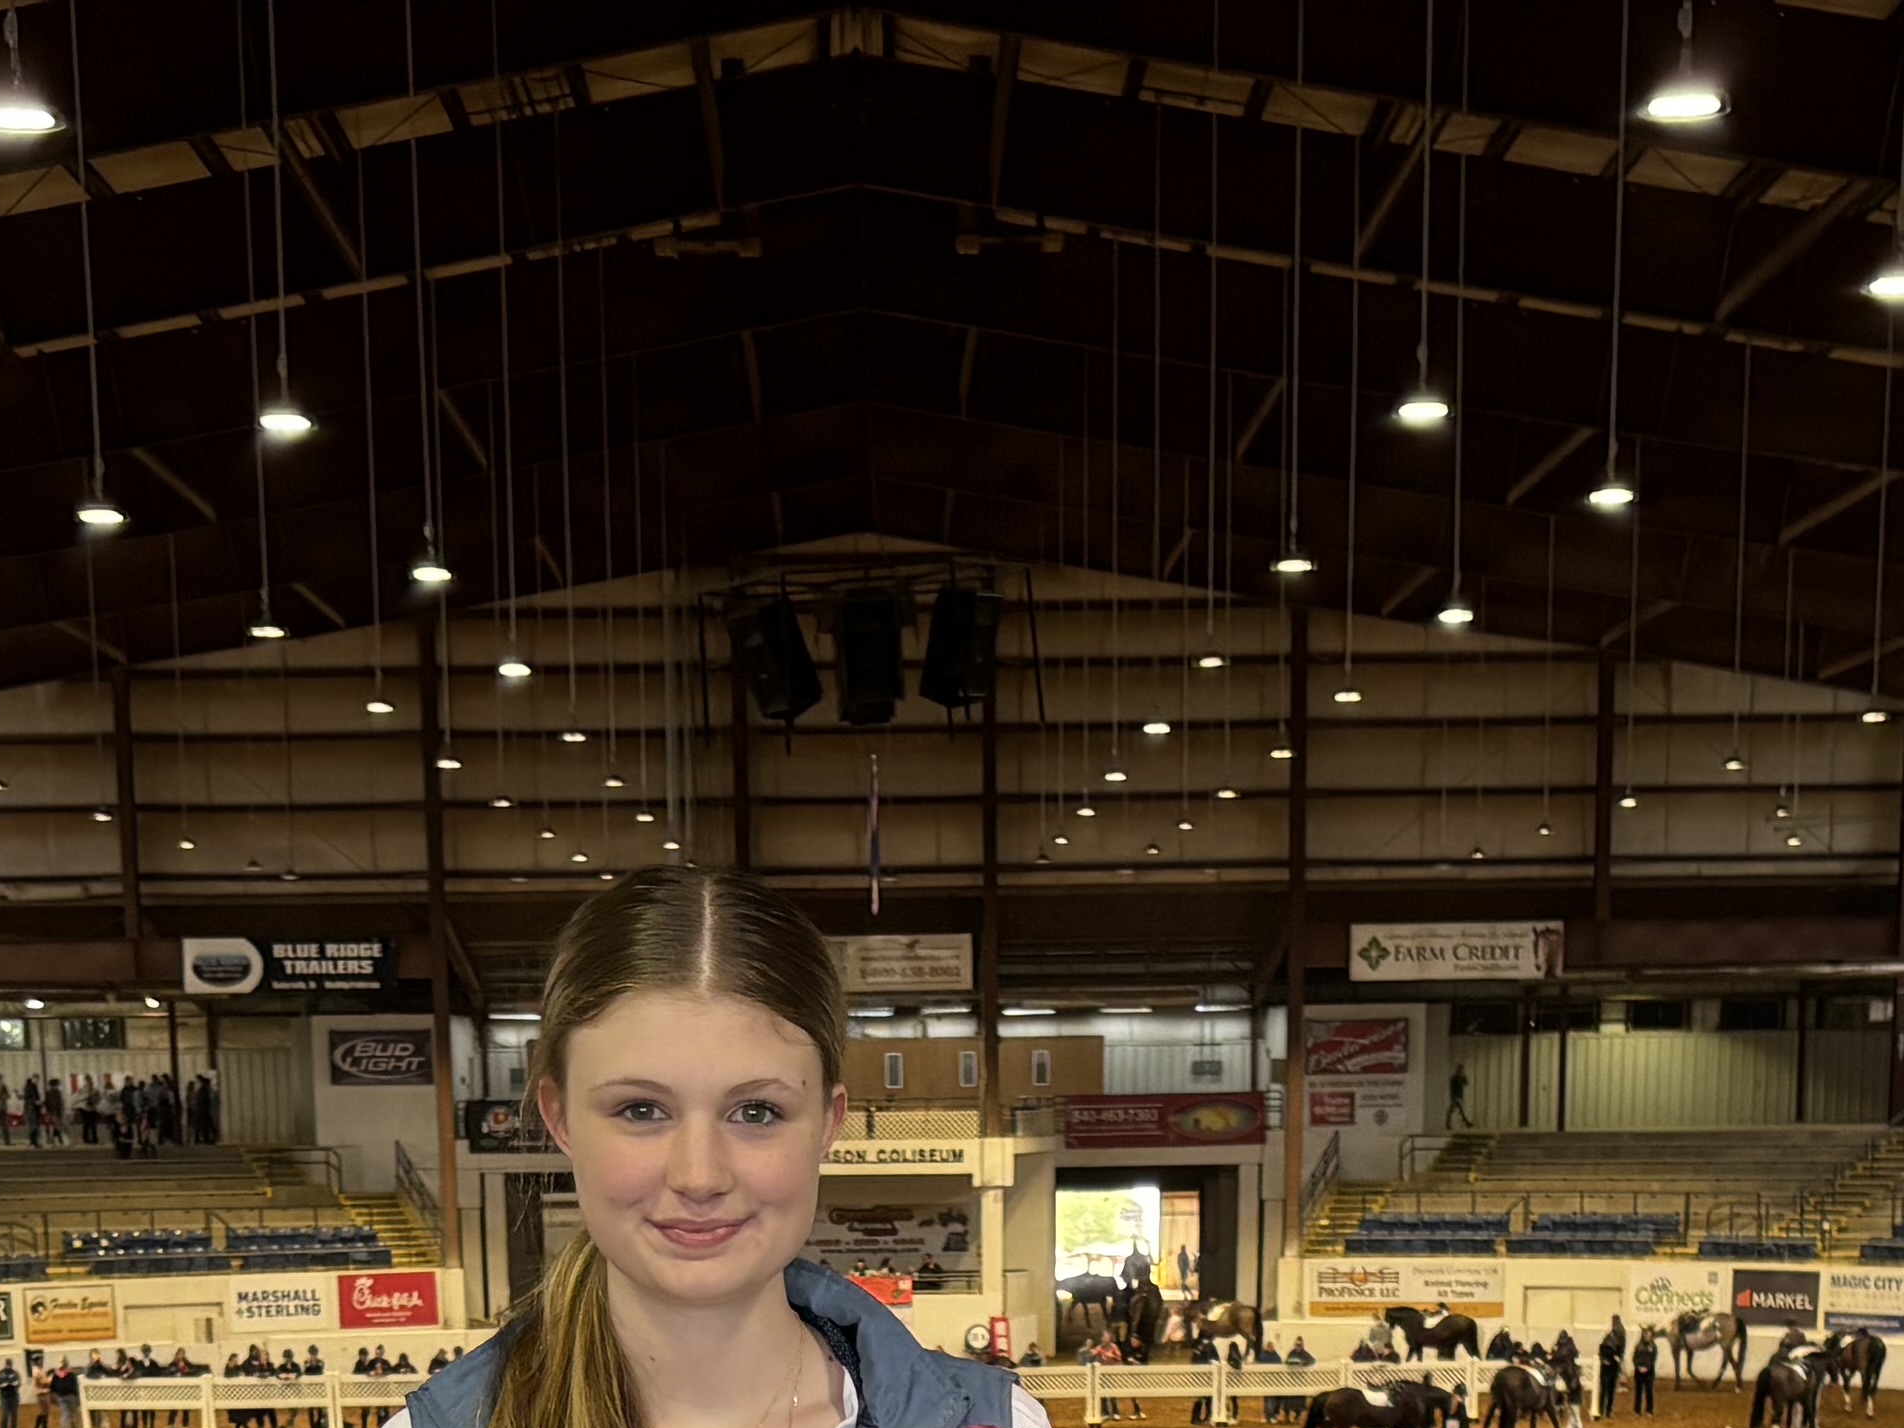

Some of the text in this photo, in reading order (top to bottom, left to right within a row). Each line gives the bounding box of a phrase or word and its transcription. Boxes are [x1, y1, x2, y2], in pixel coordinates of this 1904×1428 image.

[272, 943, 383, 958] BLUE RIDGE
[1395, 943, 1524, 962] FARM CREDIT
[284, 960, 374, 974] TRAILERS
[354, 1042, 415, 1057] BUD
[344, 1057, 426, 1072] LIGHT
[824, 1148, 964, 1163] SON COLISEUM
[1830, 1275, 1904, 1292] MAGIC CITY
[236, 1288, 321, 1304] MARSHALL
[1379, 1286, 1401, 1298] LLC
[1752, 1292, 1814, 1311] MARKEL
